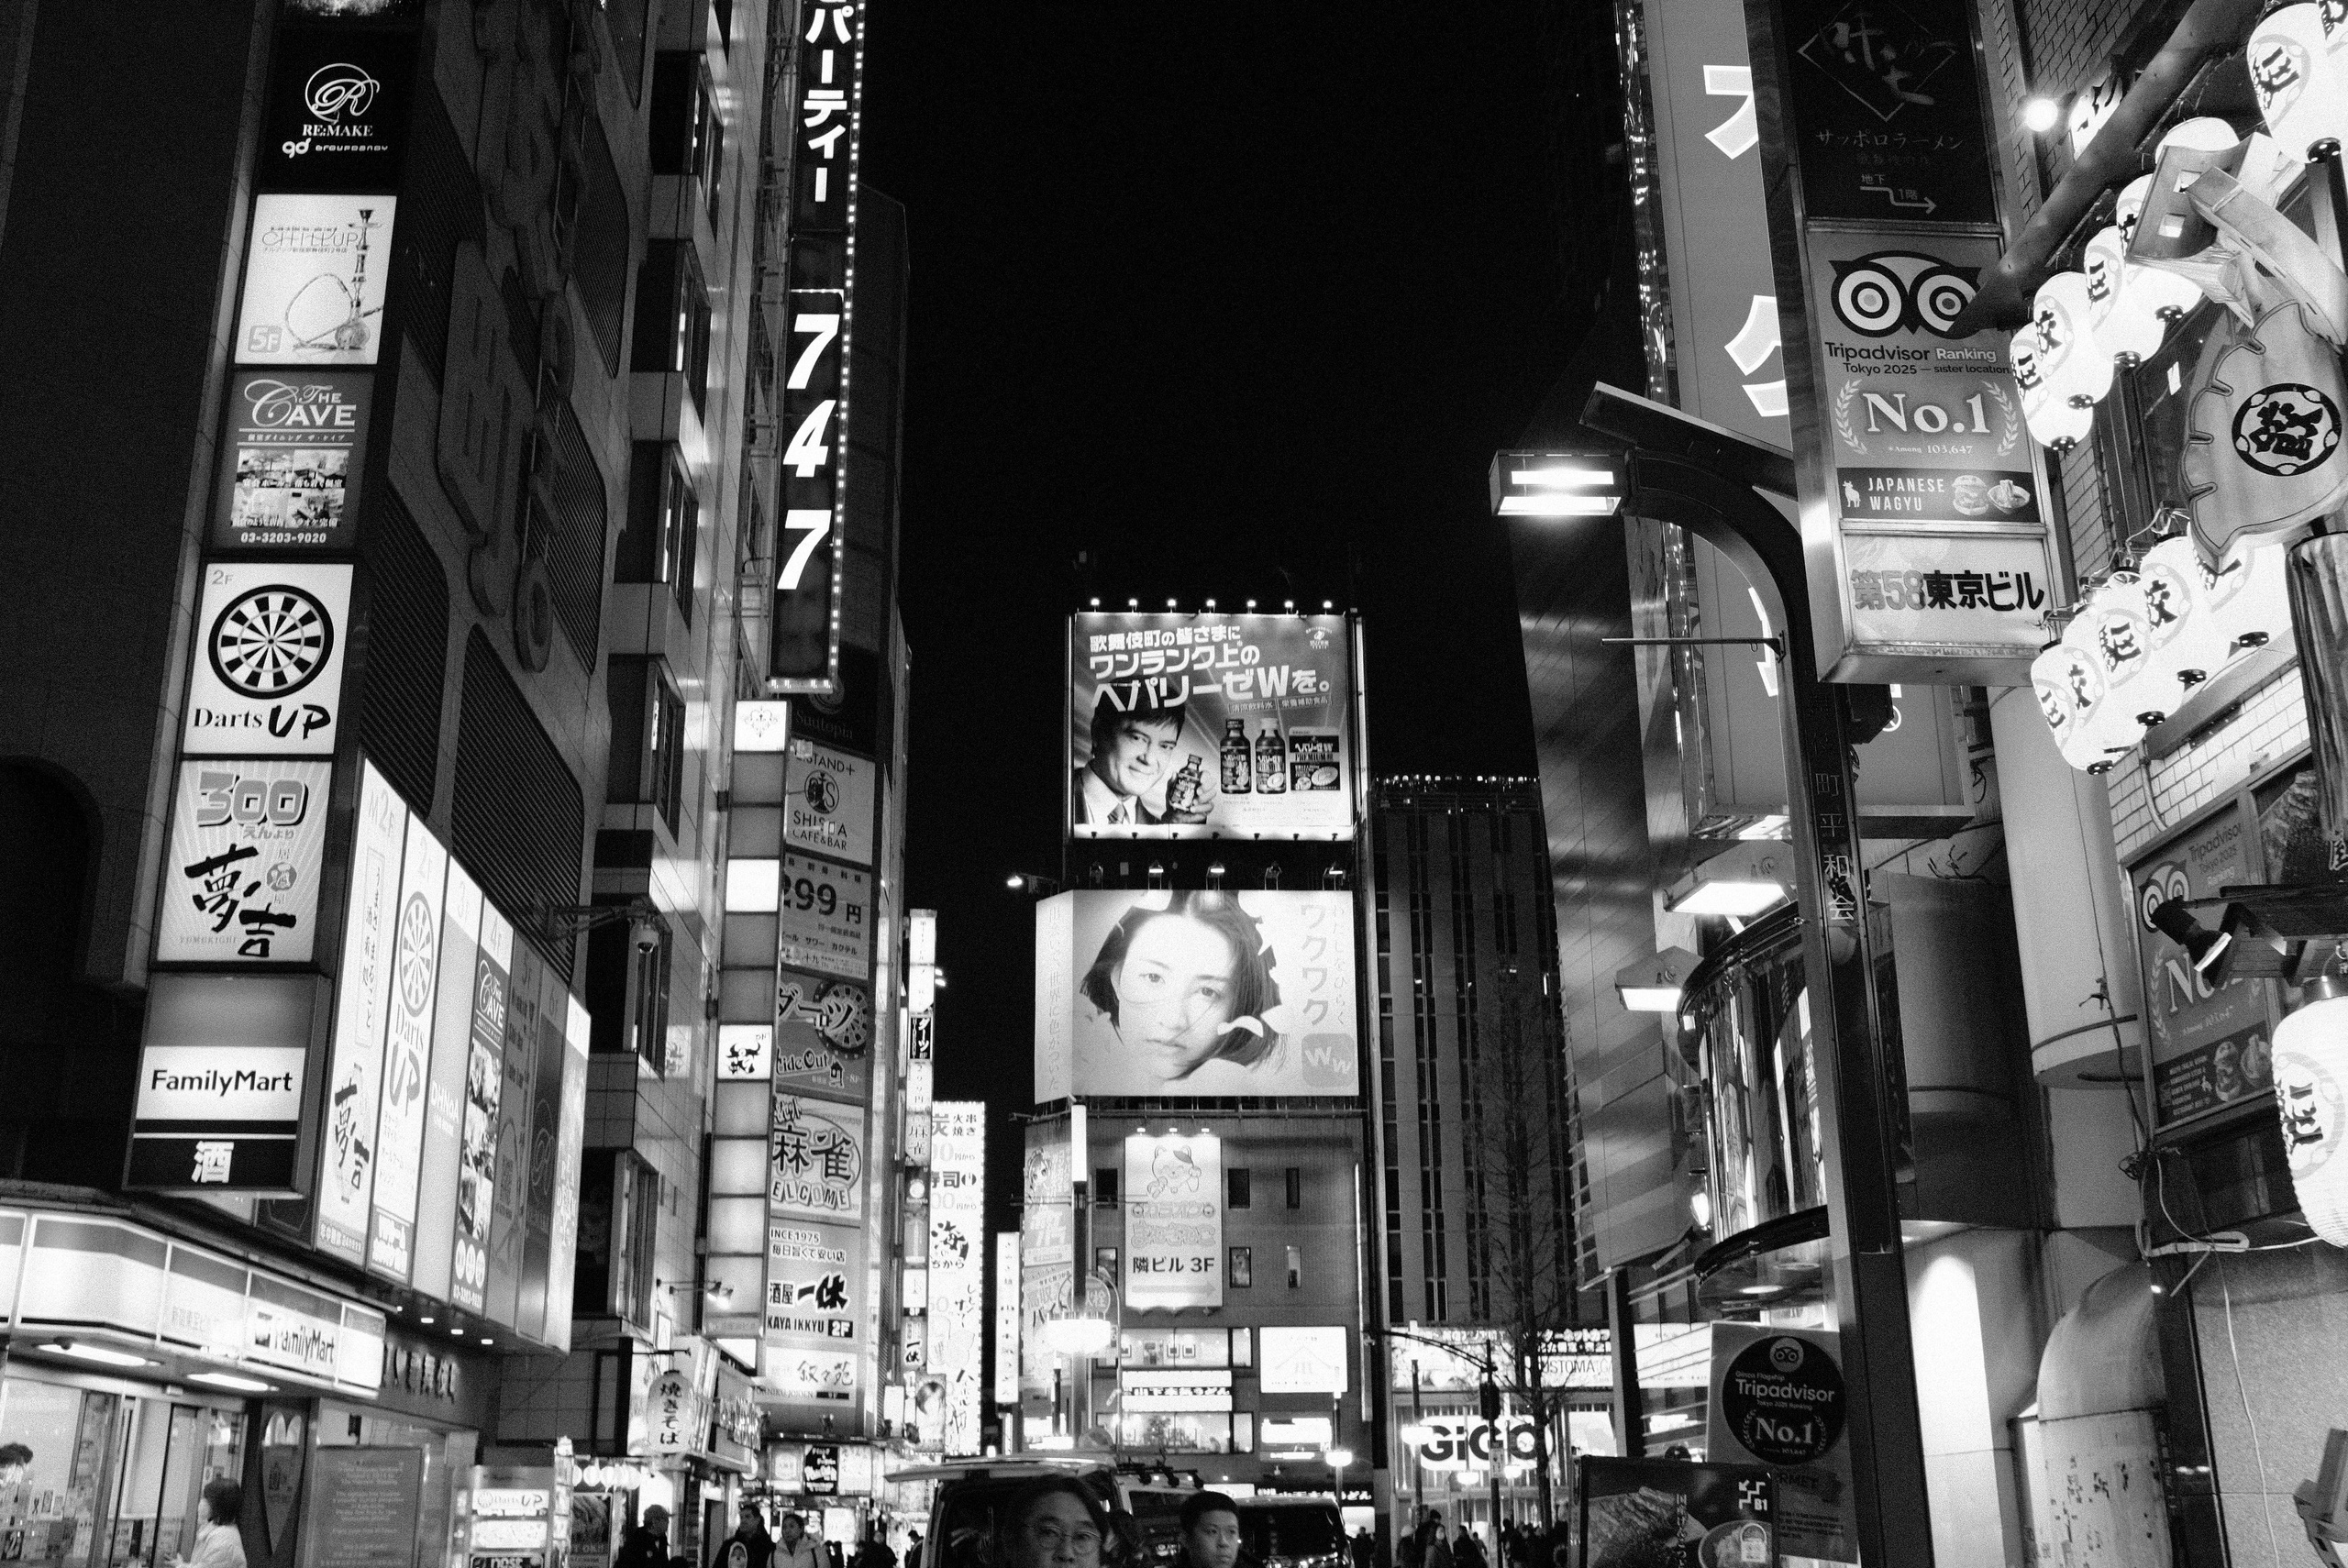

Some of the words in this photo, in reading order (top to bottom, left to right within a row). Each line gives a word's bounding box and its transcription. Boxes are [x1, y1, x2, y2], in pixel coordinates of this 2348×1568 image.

[803, 0, 855, 203] パーティー
[302, 124, 373, 137] RE:MAKE
[1815, 128, 1965, 150] サッポロラーメン
[1861, 174, 1886, 184] 地下
[1898, 189, 1918, 200] 1階
[1824, 342, 1931, 361] Tripadvisor
[1936, 348, 1997, 363] Ranking
[1843, 362, 1883, 375] Tokyo
[1883, 364, 1918, 375] 2025
[1933, 365, 1964, 374] sister
[245, 379, 356, 427] CAVE
[1863, 392, 1972, 434] No.1
[776, 314, 840, 591] 747
[1926, 444, 1973, 456] 103,647
[1868, 477, 1945, 493] JAPANESE
[1870, 495, 1923, 512] WAGYU
[240, 531, 327, 544] 03-3203-9020
[212, 569, 234, 585] 2F
[1850, 569, 2045, 612] 第58東京ビル
[1090, 625, 1242, 653] 歌舞伎町の皆さまに
[1090, 644, 1260, 679] ワンランク上の
[194, 707, 264, 728] Darts
[268, 703, 331, 741] UP
[196, 769, 309, 827] 300
[792, 810, 847, 847] SHISA
[846, 902, 862, 925] 円
[1301, 904, 1330, 1027] ワクワク
[395, 1003, 426, 1052] Darts
[151, 1069, 294, 1098] FamilyMart
[191, 1140, 235, 1183] 酒
[772, 1124, 851, 1181] 麻雀
[795, 1231, 820, 1243] 1975
[1133, 1256, 1184, 1274] 隣ビル
[1191, 1257, 1215, 1273] 3F
[797, 1275, 848, 1310] 一休
[794, 1319, 825, 1333] IKKYU
[831, 1320, 851, 1339] 2F
[797, 1360, 854, 1386] 叙々苑
[1734, 1378, 1835, 1403] Tripadvisor
[659, 1381, 683, 1445] 焼きそば
[1421, 1424, 1537, 1463] GiGO
[1755, 1417, 1813, 1445] No.1
[1754, 1498, 1768, 1512] B1
